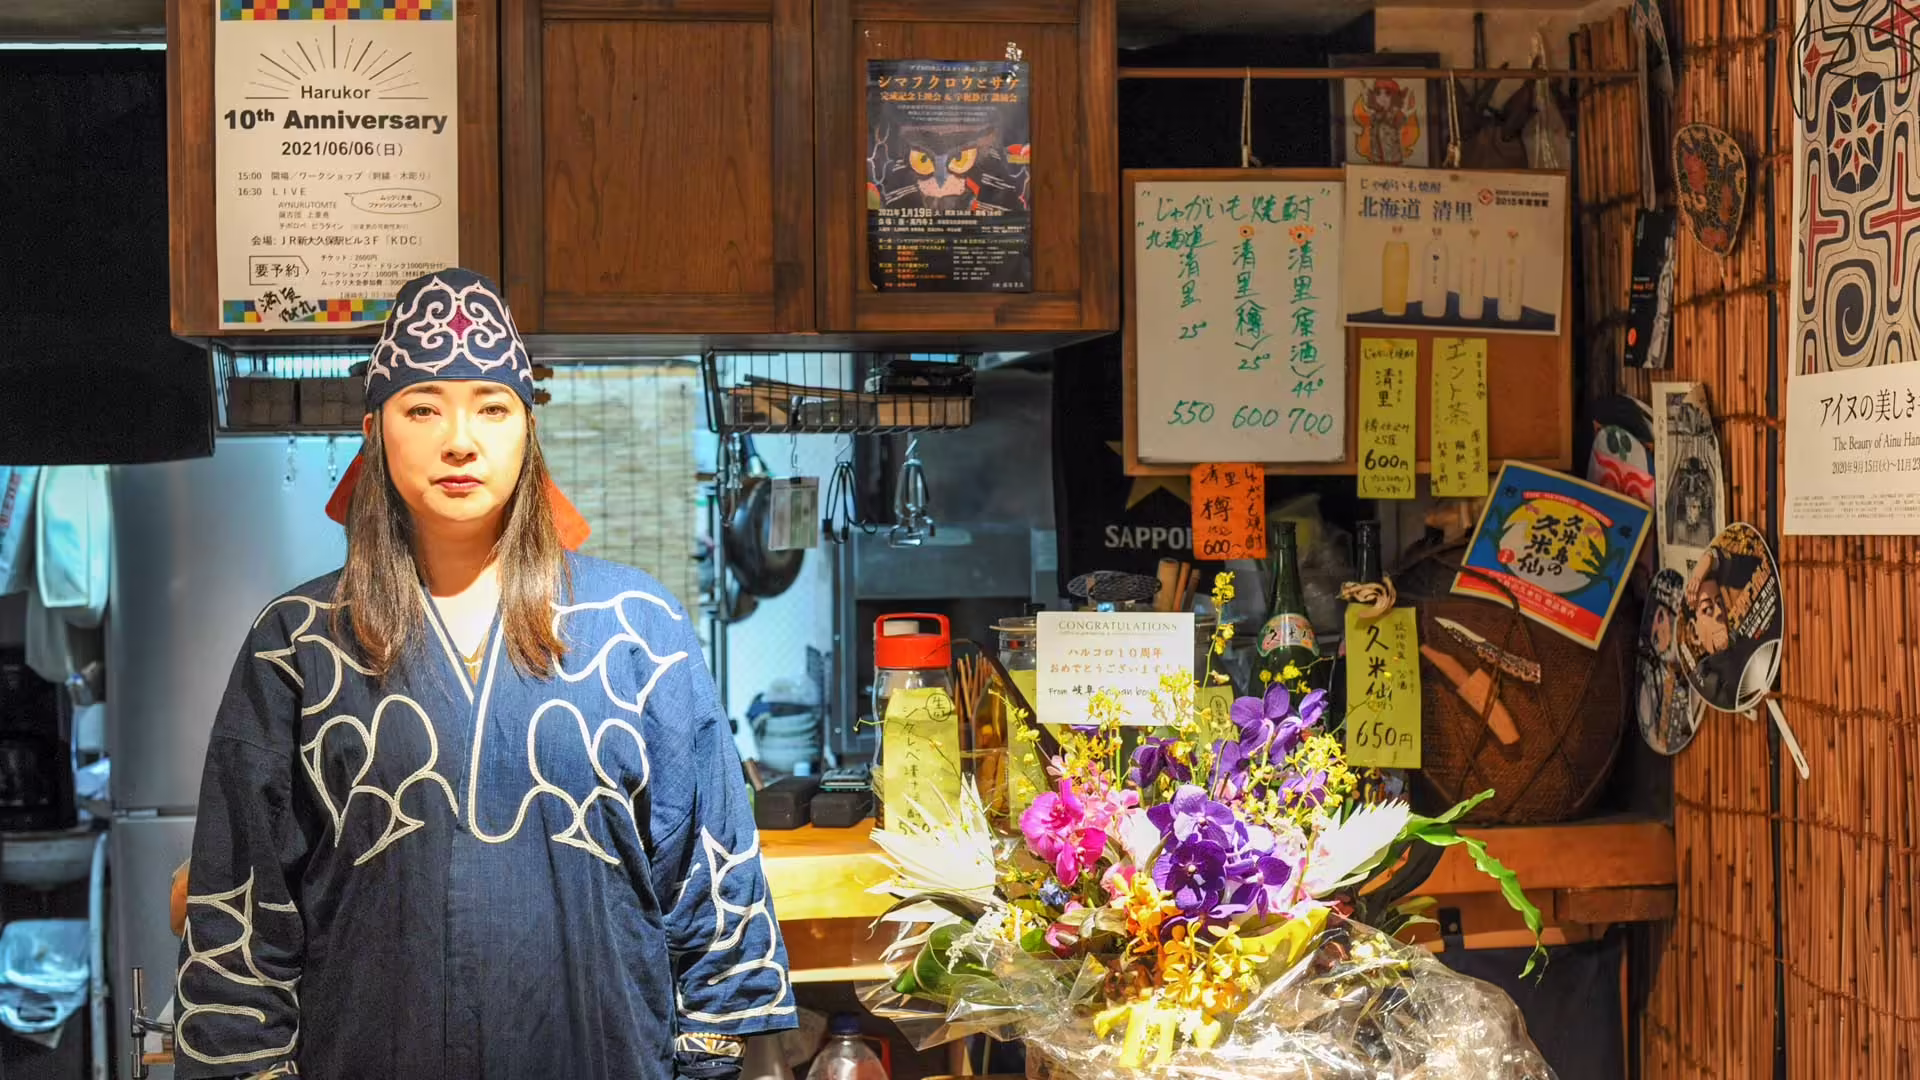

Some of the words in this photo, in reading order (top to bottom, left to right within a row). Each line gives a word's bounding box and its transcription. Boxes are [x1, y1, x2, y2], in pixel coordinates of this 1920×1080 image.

[300, 85, 371, 99] Harukor
[879, 75, 1020, 90] シマフクロウとサケ
[224, 109, 275, 130] 10th
[283, 110, 447, 135] Anniversary
[238, 171, 262, 181] 15:00
[238, 187, 262, 197] 16:30
[272, 187, 307, 196] LIVE
[1359, 195, 1421, 220] 北海道
[1432, 199, 1473, 223] 清里
[254, 262, 300, 279] 要予約
[1375, 367, 1393, 409] 清里
[1167, 399, 1215, 426] 550
[1232, 405, 1280, 429] 600
[1287, 407, 1334, 435] 700
[1820, 387, 1920, 428] アイヌの美しき
[1832, 436, 1847, 452] The
[1849, 435, 1873, 455] Beauty
[1874, 432, 1884, 449] of
[1883, 433, 1902, 449] Ainu
[1364, 448, 1410, 471] 600円
[1199, 464, 1241, 490] 清里
[1199, 495, 1233, 523] 樽
[1517, 514, 1561, 578] 久米仙
[1058, 620, 1178, 634] CONGRATULATIONS
[1364, 624, 1393, 702] 久米仙
[1048, 687, 1068, 698] From
[1071, 684, 1096, 698] 岐阜
[1355, 718, 1415, 752] 650円
